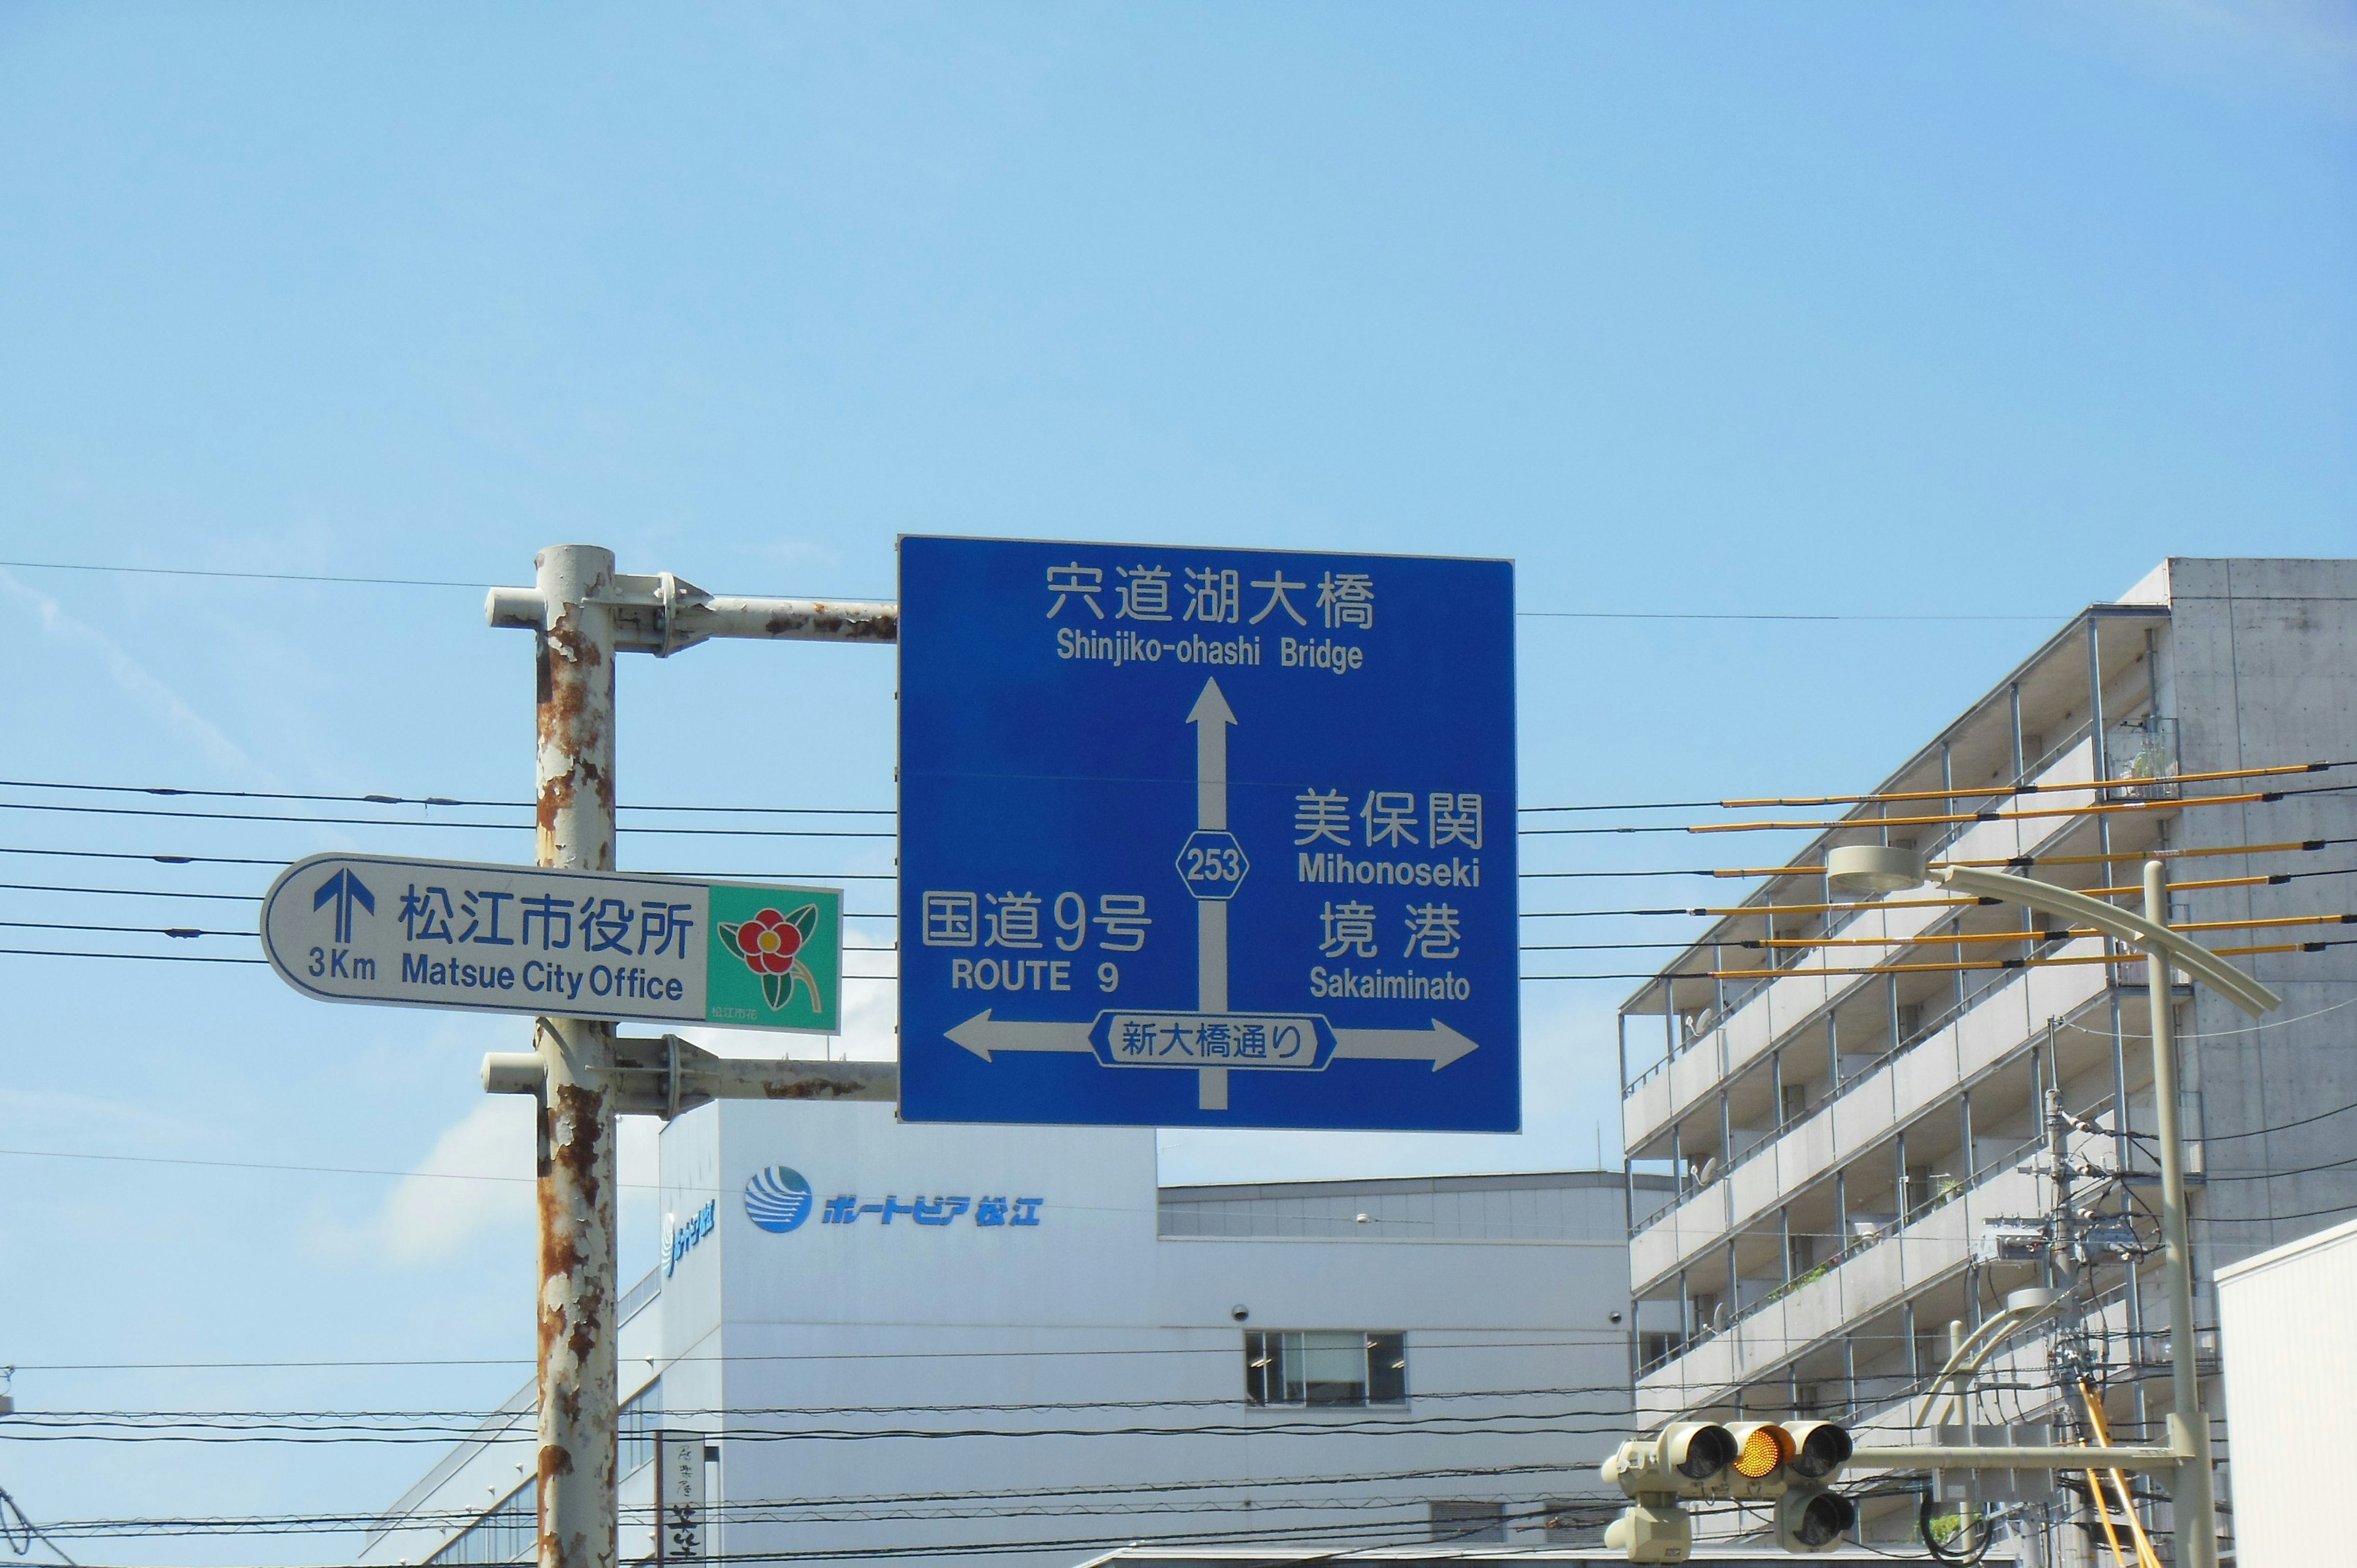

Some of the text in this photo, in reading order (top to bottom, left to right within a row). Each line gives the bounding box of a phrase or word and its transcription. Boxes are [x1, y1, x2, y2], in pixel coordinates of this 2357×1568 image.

[1047, 562, 1375, 629] 宍道湖大橋
[1056, 628, 1363, 674] Shinjiko-ohashi Bridge
[1294, 787, 1482, 850] 美保関
[1188, 848, 1239, 881] 253
[1299, 852, 1479, 887] Mihonoseki
[399, 884, 694, 959] 松江市役所
[922, 890, 1153, 952] 国道9号
[403, 954, 684, 1002] Matsue City Office
[952, 958, 1119, 993] ROUTE 9
[1310, 967, 1471, 1000] Sakaiminato
[1122, 1021, 1301, 1059] 新大橋通り
